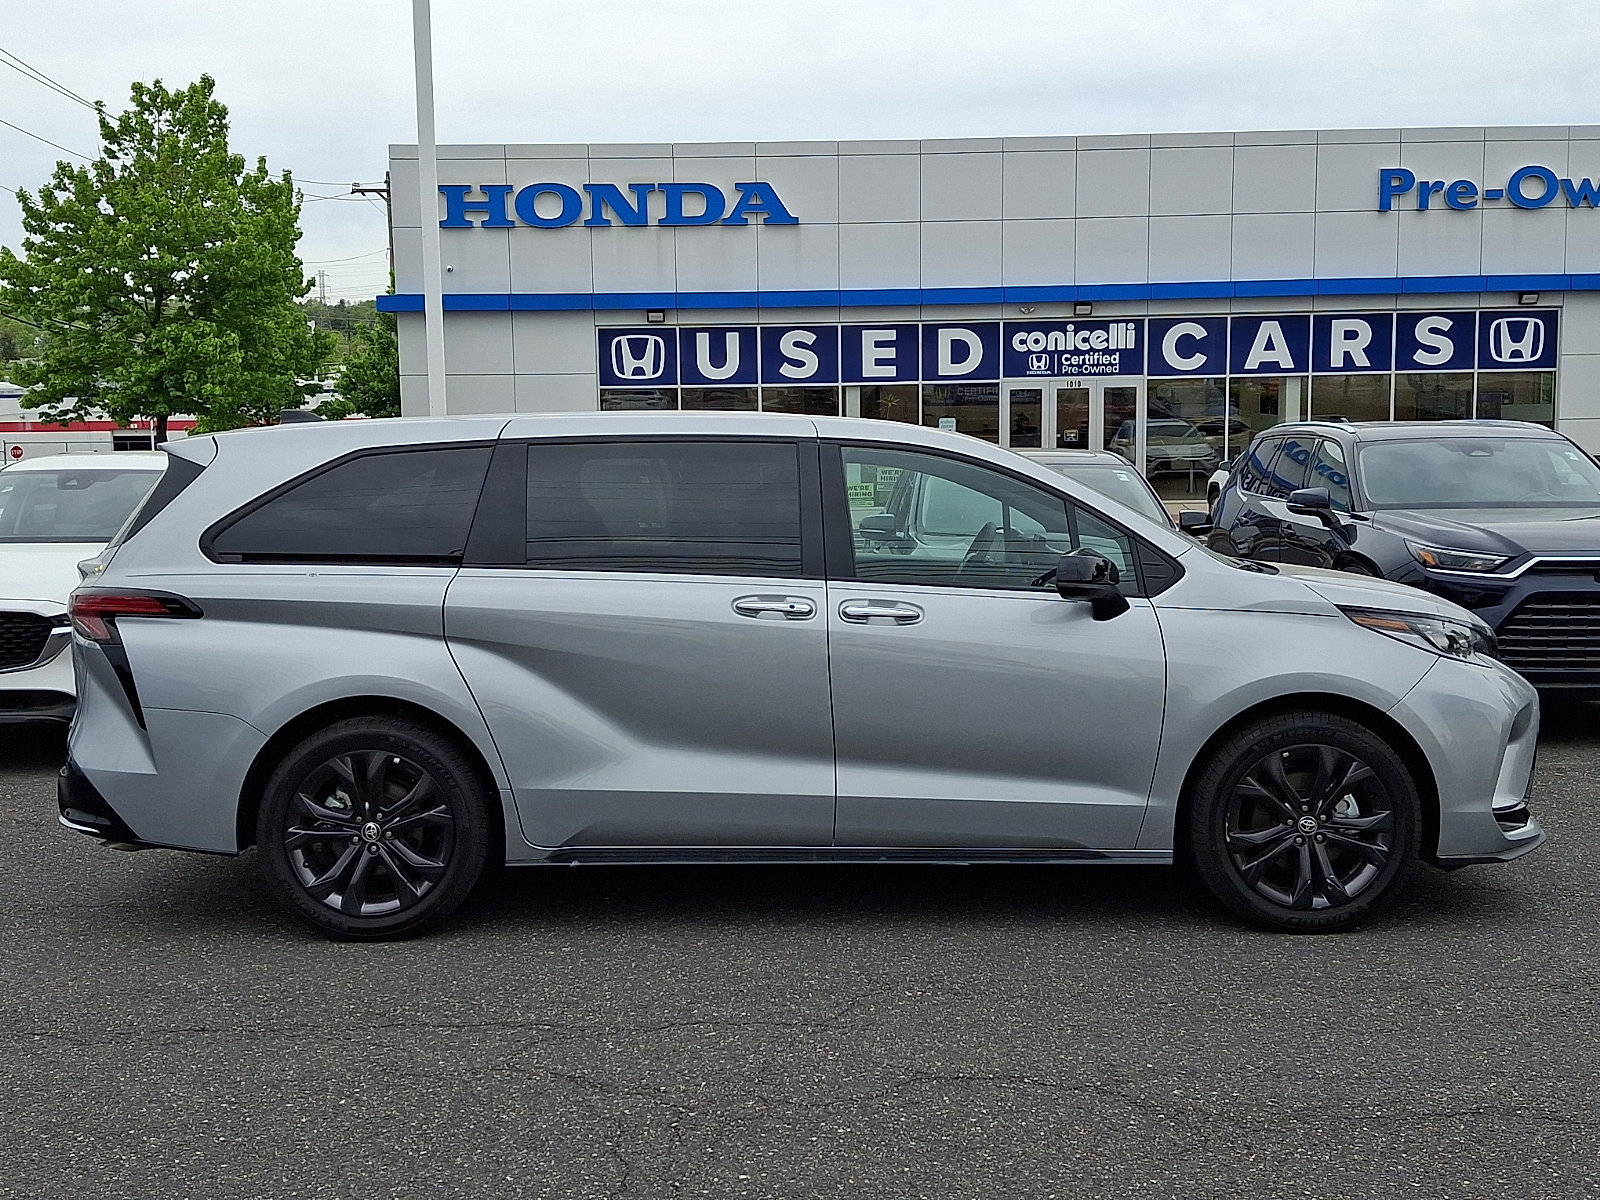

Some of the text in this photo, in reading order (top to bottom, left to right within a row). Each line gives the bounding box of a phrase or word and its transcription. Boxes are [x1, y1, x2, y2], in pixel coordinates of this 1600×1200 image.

[438, 182, 800, 229] HONDA
[696, 328, 983, 380] USED
[1012, 322, 1135, 352] conicelli
[1161, 316, 1454, 371] CARS
[1061, 351, 1120, 365] Certified
[1062, 364, 1120, 374] Pre-Owned
